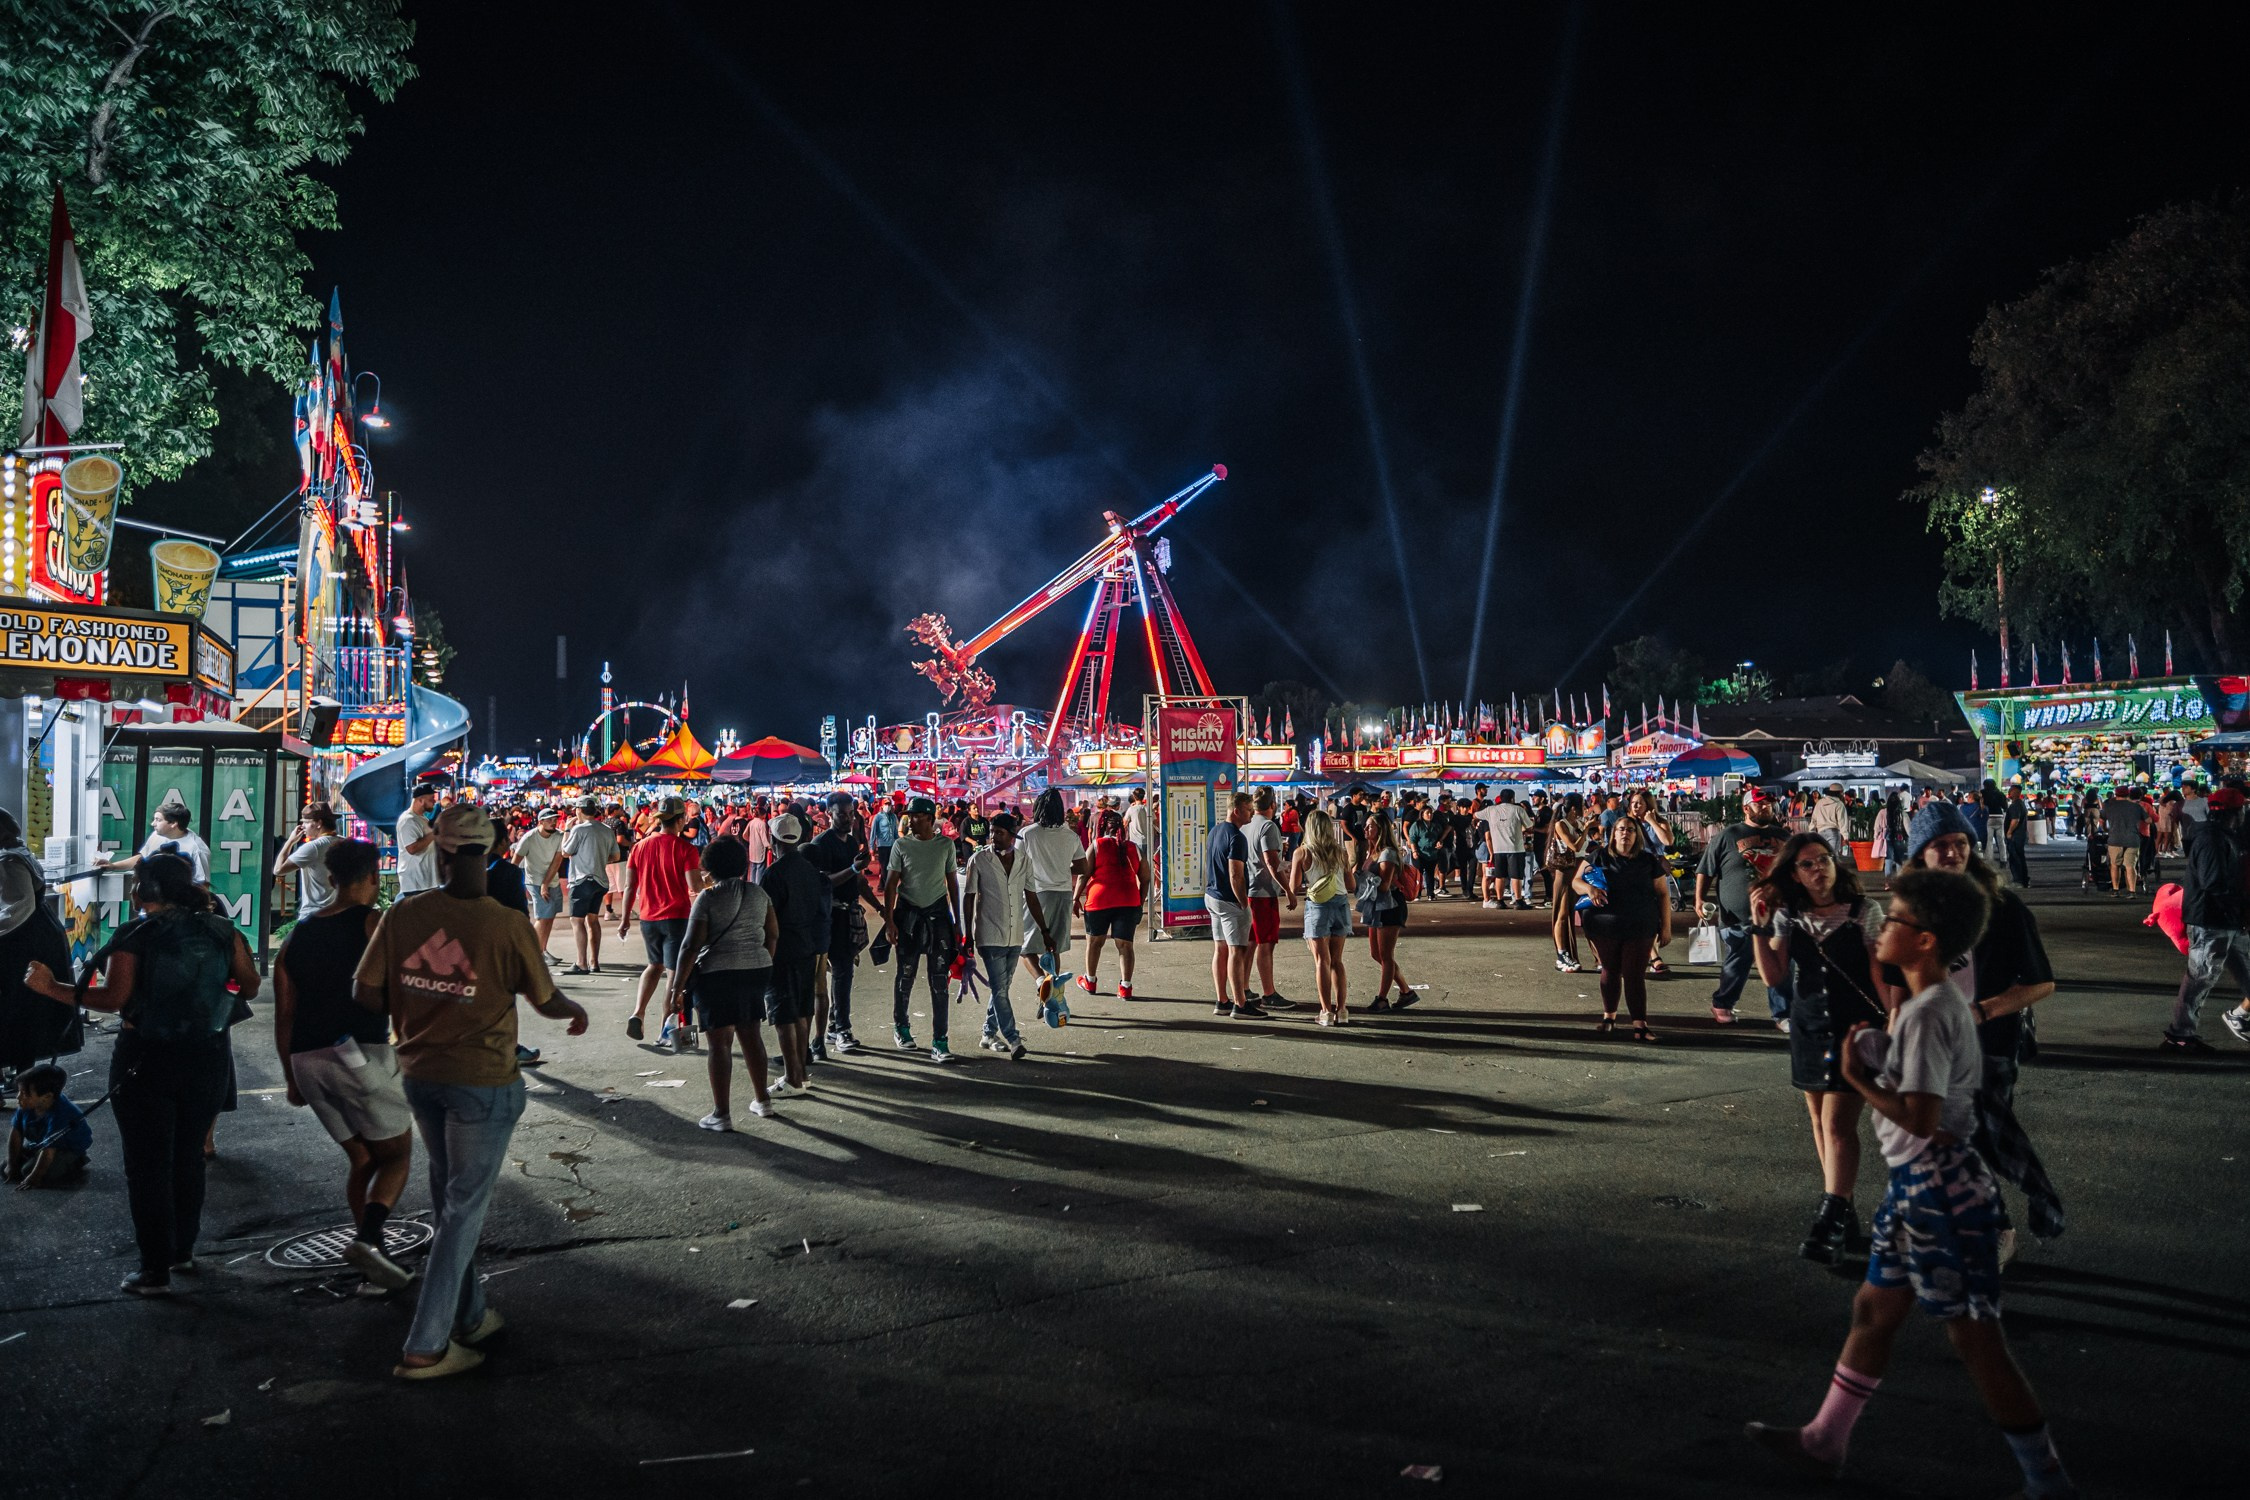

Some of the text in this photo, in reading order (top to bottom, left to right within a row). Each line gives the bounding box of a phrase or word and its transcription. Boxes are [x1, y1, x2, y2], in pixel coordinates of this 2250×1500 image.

[0, 614, 168, 642] OLD FASHIONED
[0, 632, 175, 669] EMONADE
[2023, 699, 2117, 730] WHOPPER
[1171, 728, 1224, 740] MIGHTY
[1171, 740, 1224, 752] MIDWAY
[1628, 745, 1652, 755] SHARP
[112, 754, 135, 762] ATM
[151, 755, 200, 764] ATM ATM
[217, 756, 264, 765] ATM ATM
[1468, 751, 1525, 761] TICKETS
[218, 788, 256, 926] ATM
